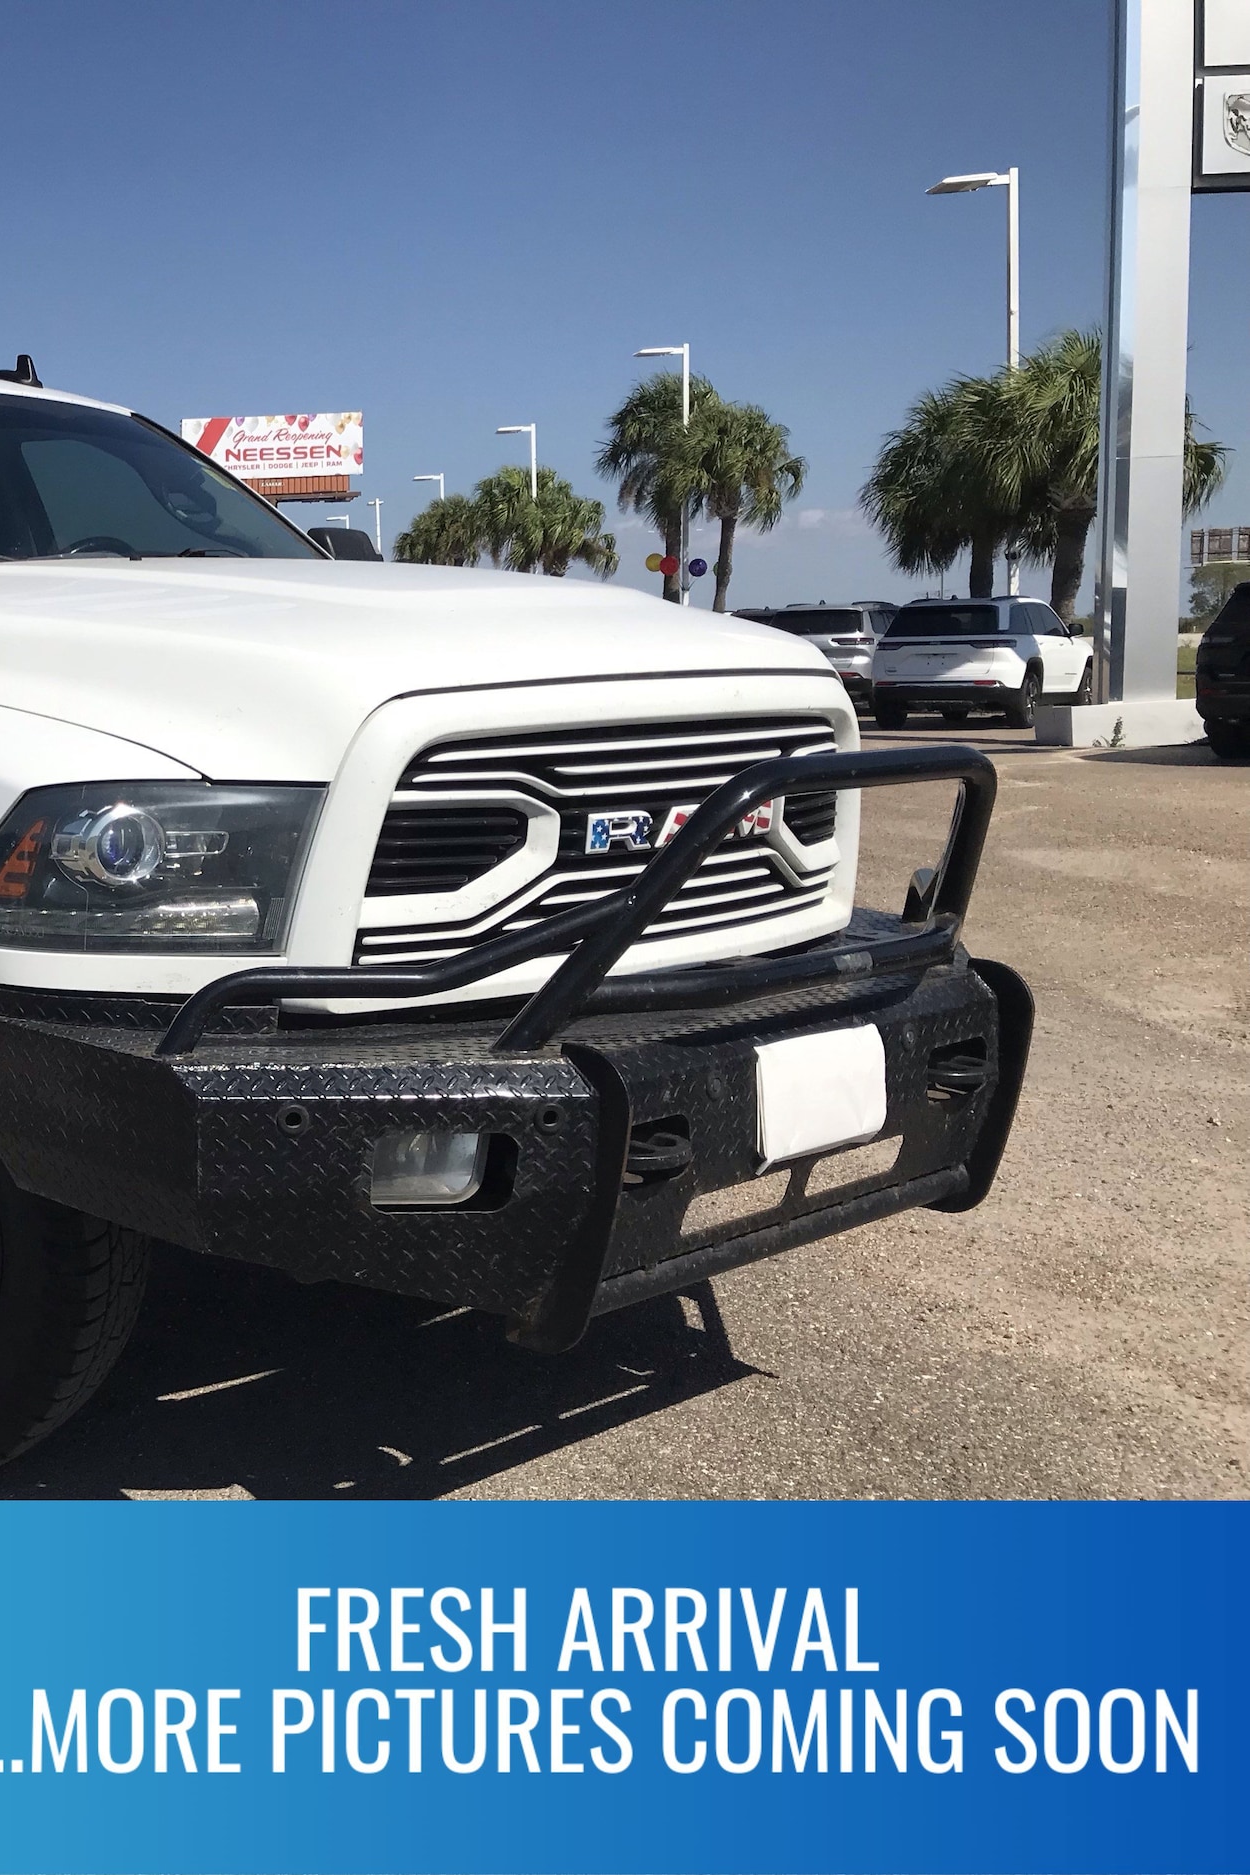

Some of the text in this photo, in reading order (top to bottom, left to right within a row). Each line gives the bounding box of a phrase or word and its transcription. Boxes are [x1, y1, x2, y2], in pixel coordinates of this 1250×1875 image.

[233, 428, 333, 449] Grand Reopening
[225, 444, 342, 462] NEESSEN
[268, 462, 293, 470] DODGE
[301, 461, 319, 469] JEEP
[326, 460, 342, 468] RAM
